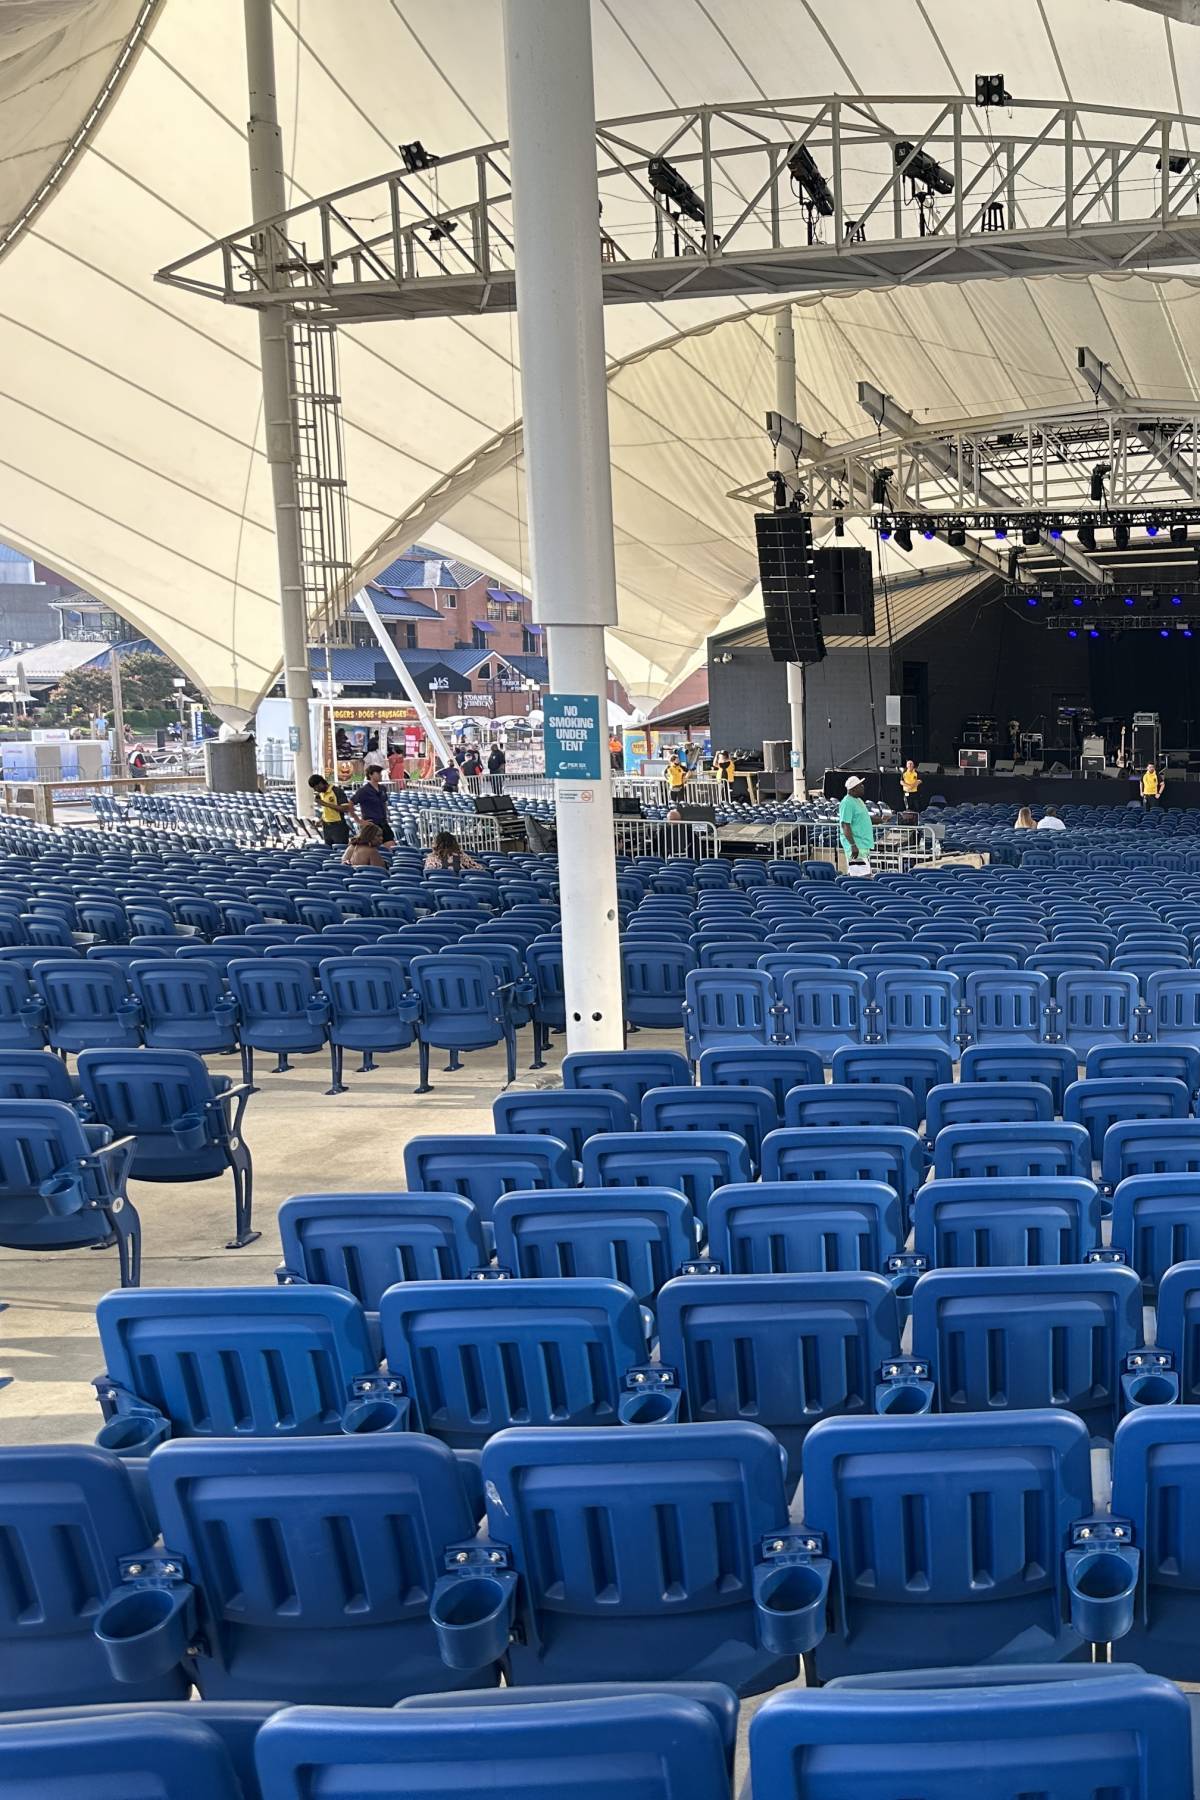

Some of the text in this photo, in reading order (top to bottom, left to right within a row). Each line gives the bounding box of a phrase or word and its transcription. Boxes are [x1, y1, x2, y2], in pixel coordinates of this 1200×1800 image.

[358, 710, 374, 718] DOGS
[377, 710, 407, 718] SAUSAGES
[563, 705, 578, 717] NO
[549, 717, 594, 729] SMOKING
[556, 729, 588, 740] UNDER
[560, 740, 585, 752] TENT
